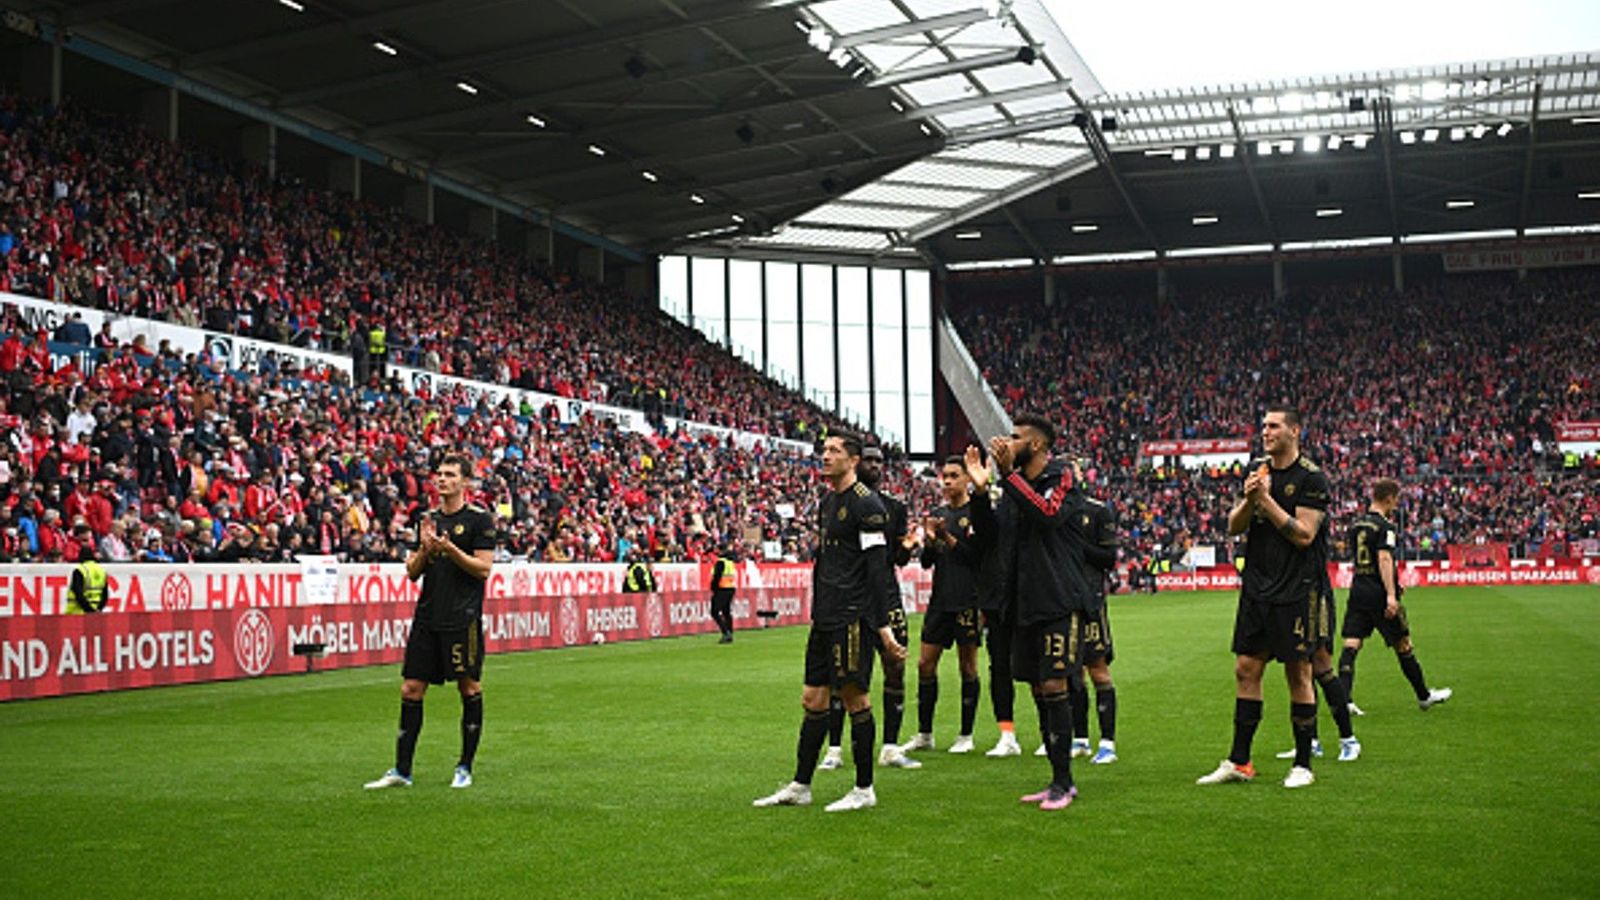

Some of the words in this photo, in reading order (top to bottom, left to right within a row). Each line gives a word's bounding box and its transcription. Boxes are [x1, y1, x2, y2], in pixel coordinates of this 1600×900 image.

[1356, 529, 1370, 564] 6
[1510, 569, 1579, 581] SPARKASSE
[287, 614, 359, 658] MÖBEL
[1292, 615, 1305, 639] 4
[0, 638, 49, 680] ND
[57, 635, 109, 675] ALL
[115, 629, 215, 671] HOTELS
[451, 642, 463, 664] 5
[1043, 632, 1066, 656] 13
